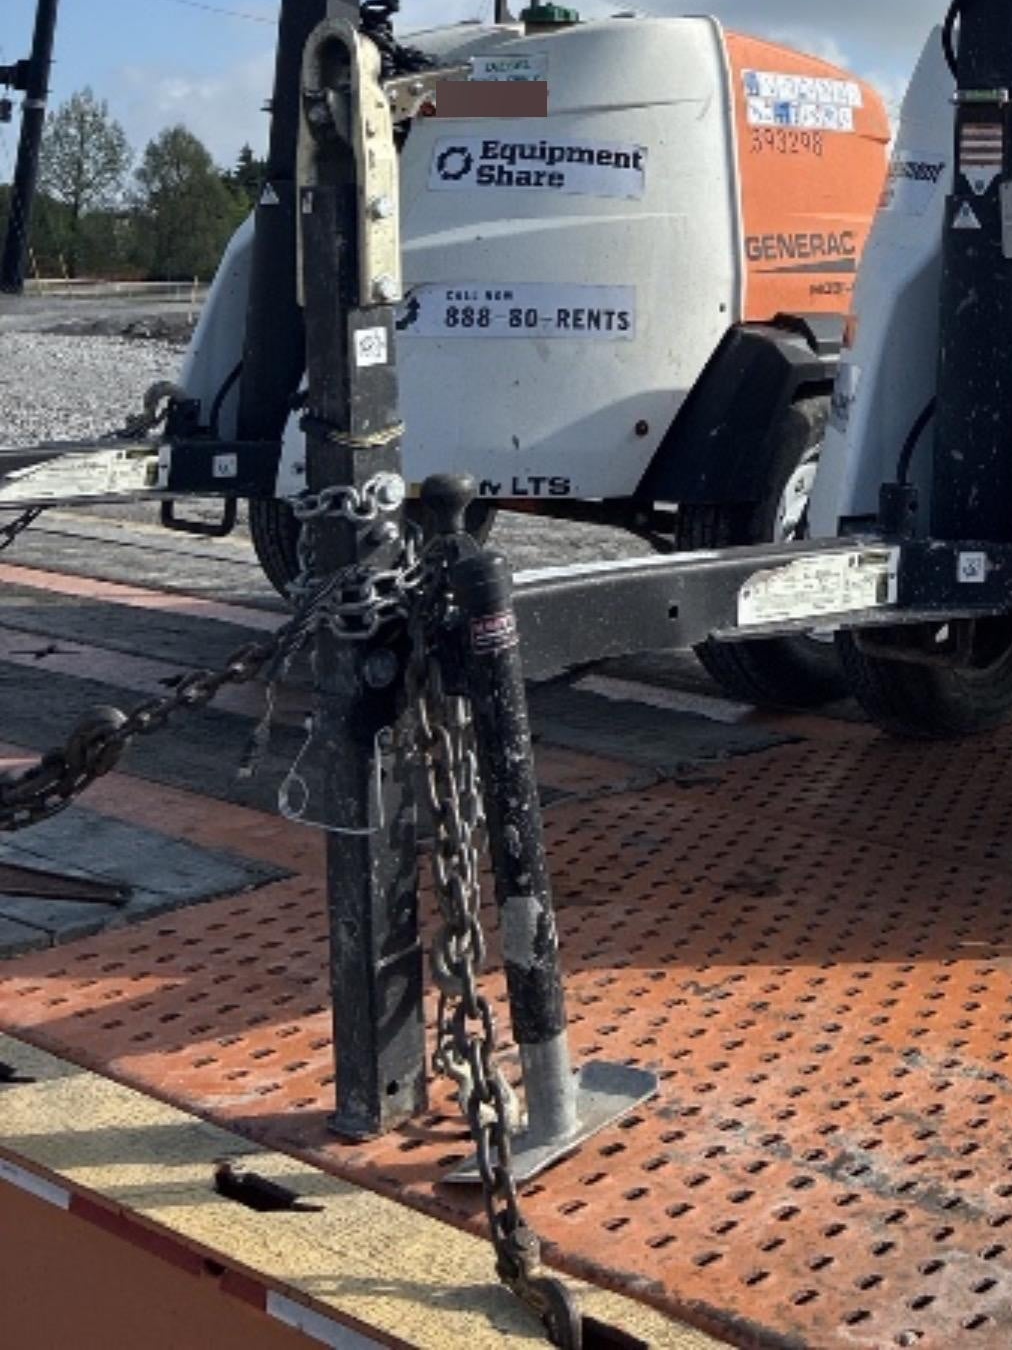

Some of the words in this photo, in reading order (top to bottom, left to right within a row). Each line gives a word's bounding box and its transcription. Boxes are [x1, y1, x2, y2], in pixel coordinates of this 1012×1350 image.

[479, 140, 643, 171] Equipment
[476, 164, 565, 188] Share
[745, 230, 856, 261] GENERAC
[445, 305, 630, 331] 888-80-RENTS
